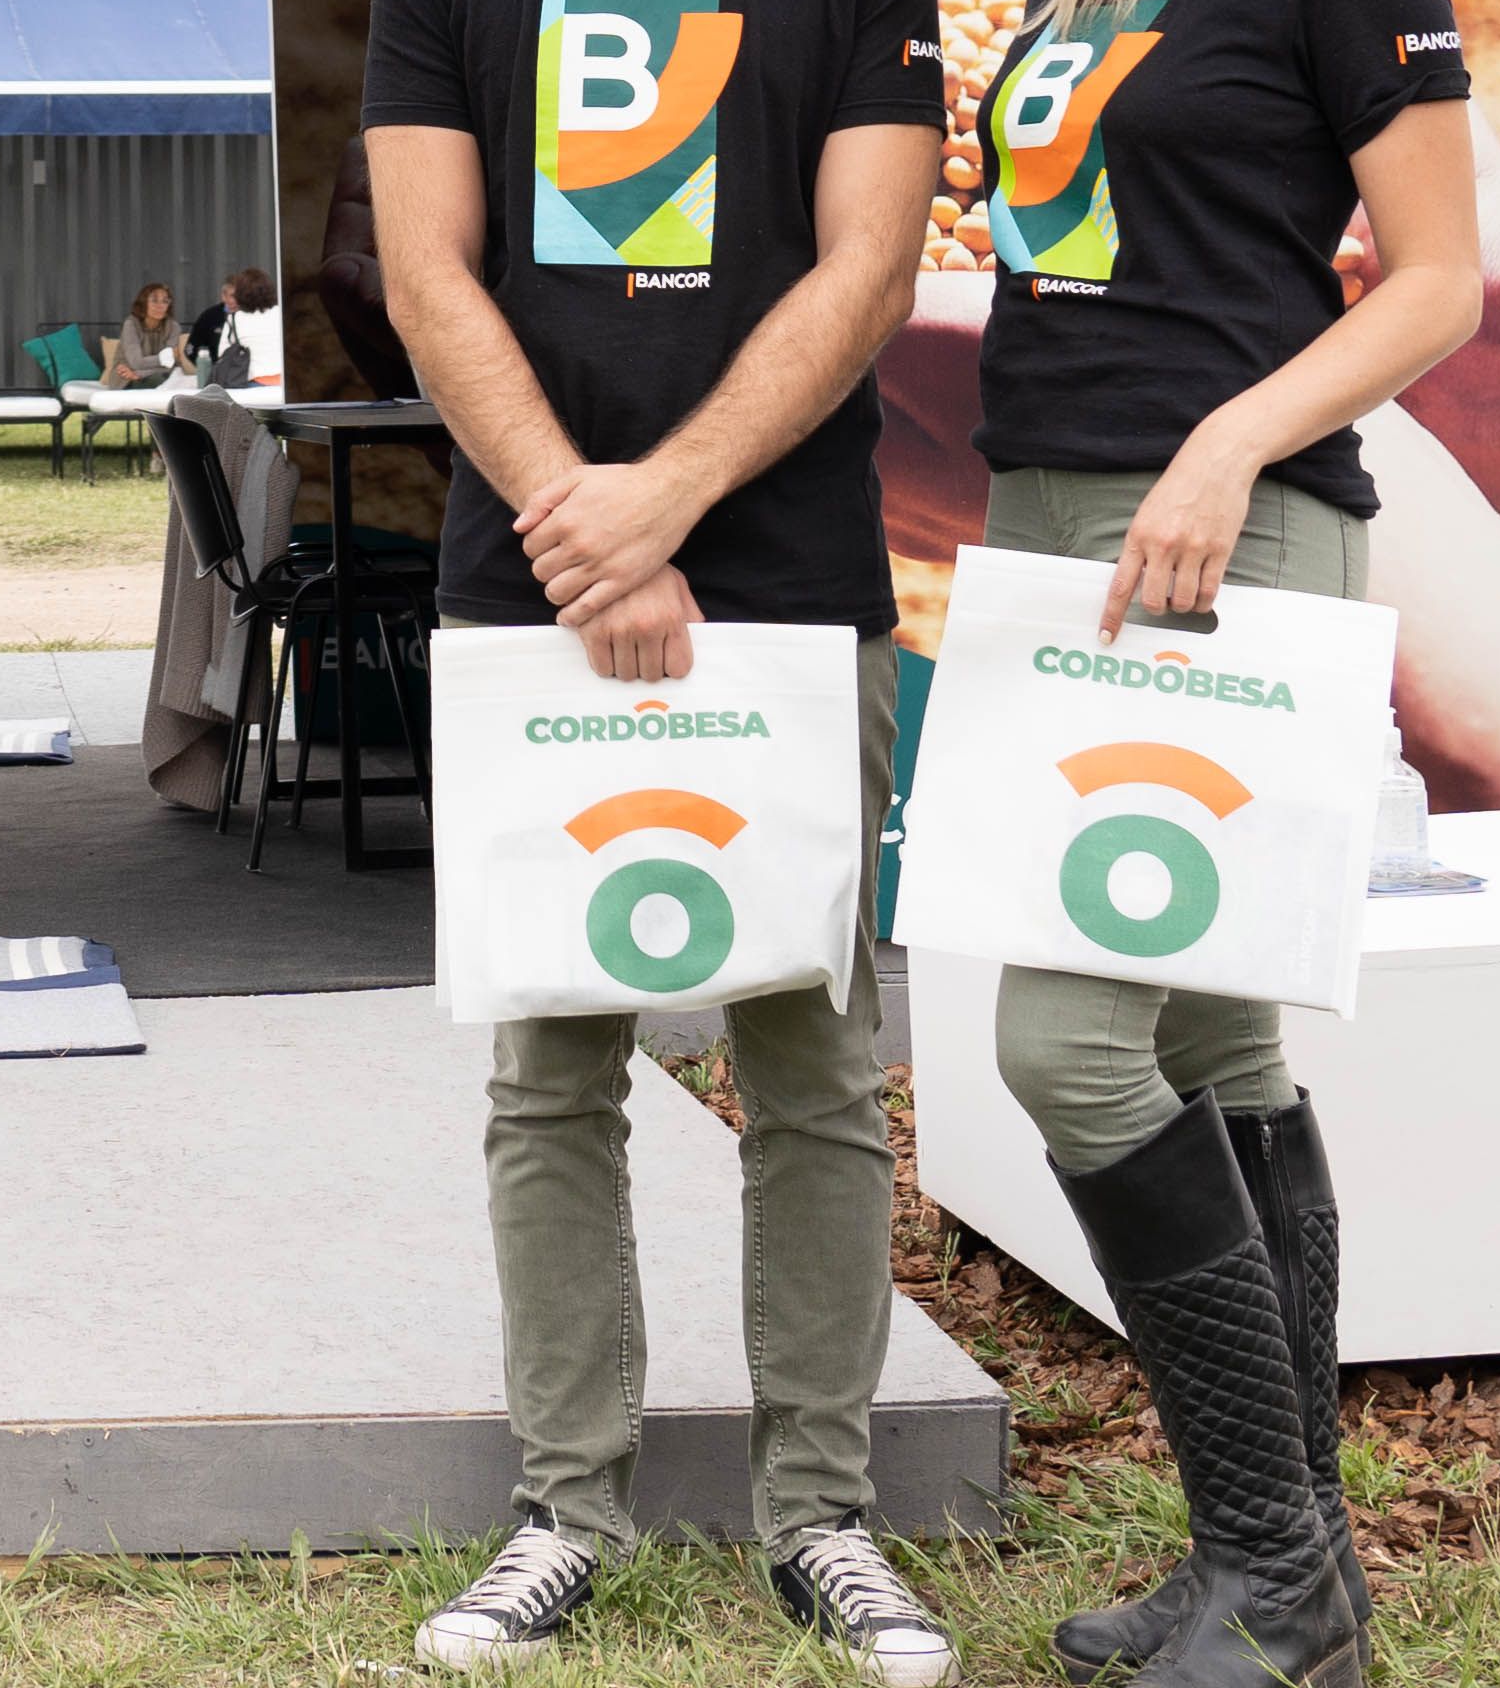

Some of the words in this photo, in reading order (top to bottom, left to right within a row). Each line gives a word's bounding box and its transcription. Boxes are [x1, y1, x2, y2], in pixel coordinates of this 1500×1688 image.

[910, 39, 943, 64] BANC
[558, 13, 659, 131] B
[1004, 42, 1093, 148] B
[635, 272, 710, 289] BANCOR
[1037, 279, 1108, 296] BANCOR
